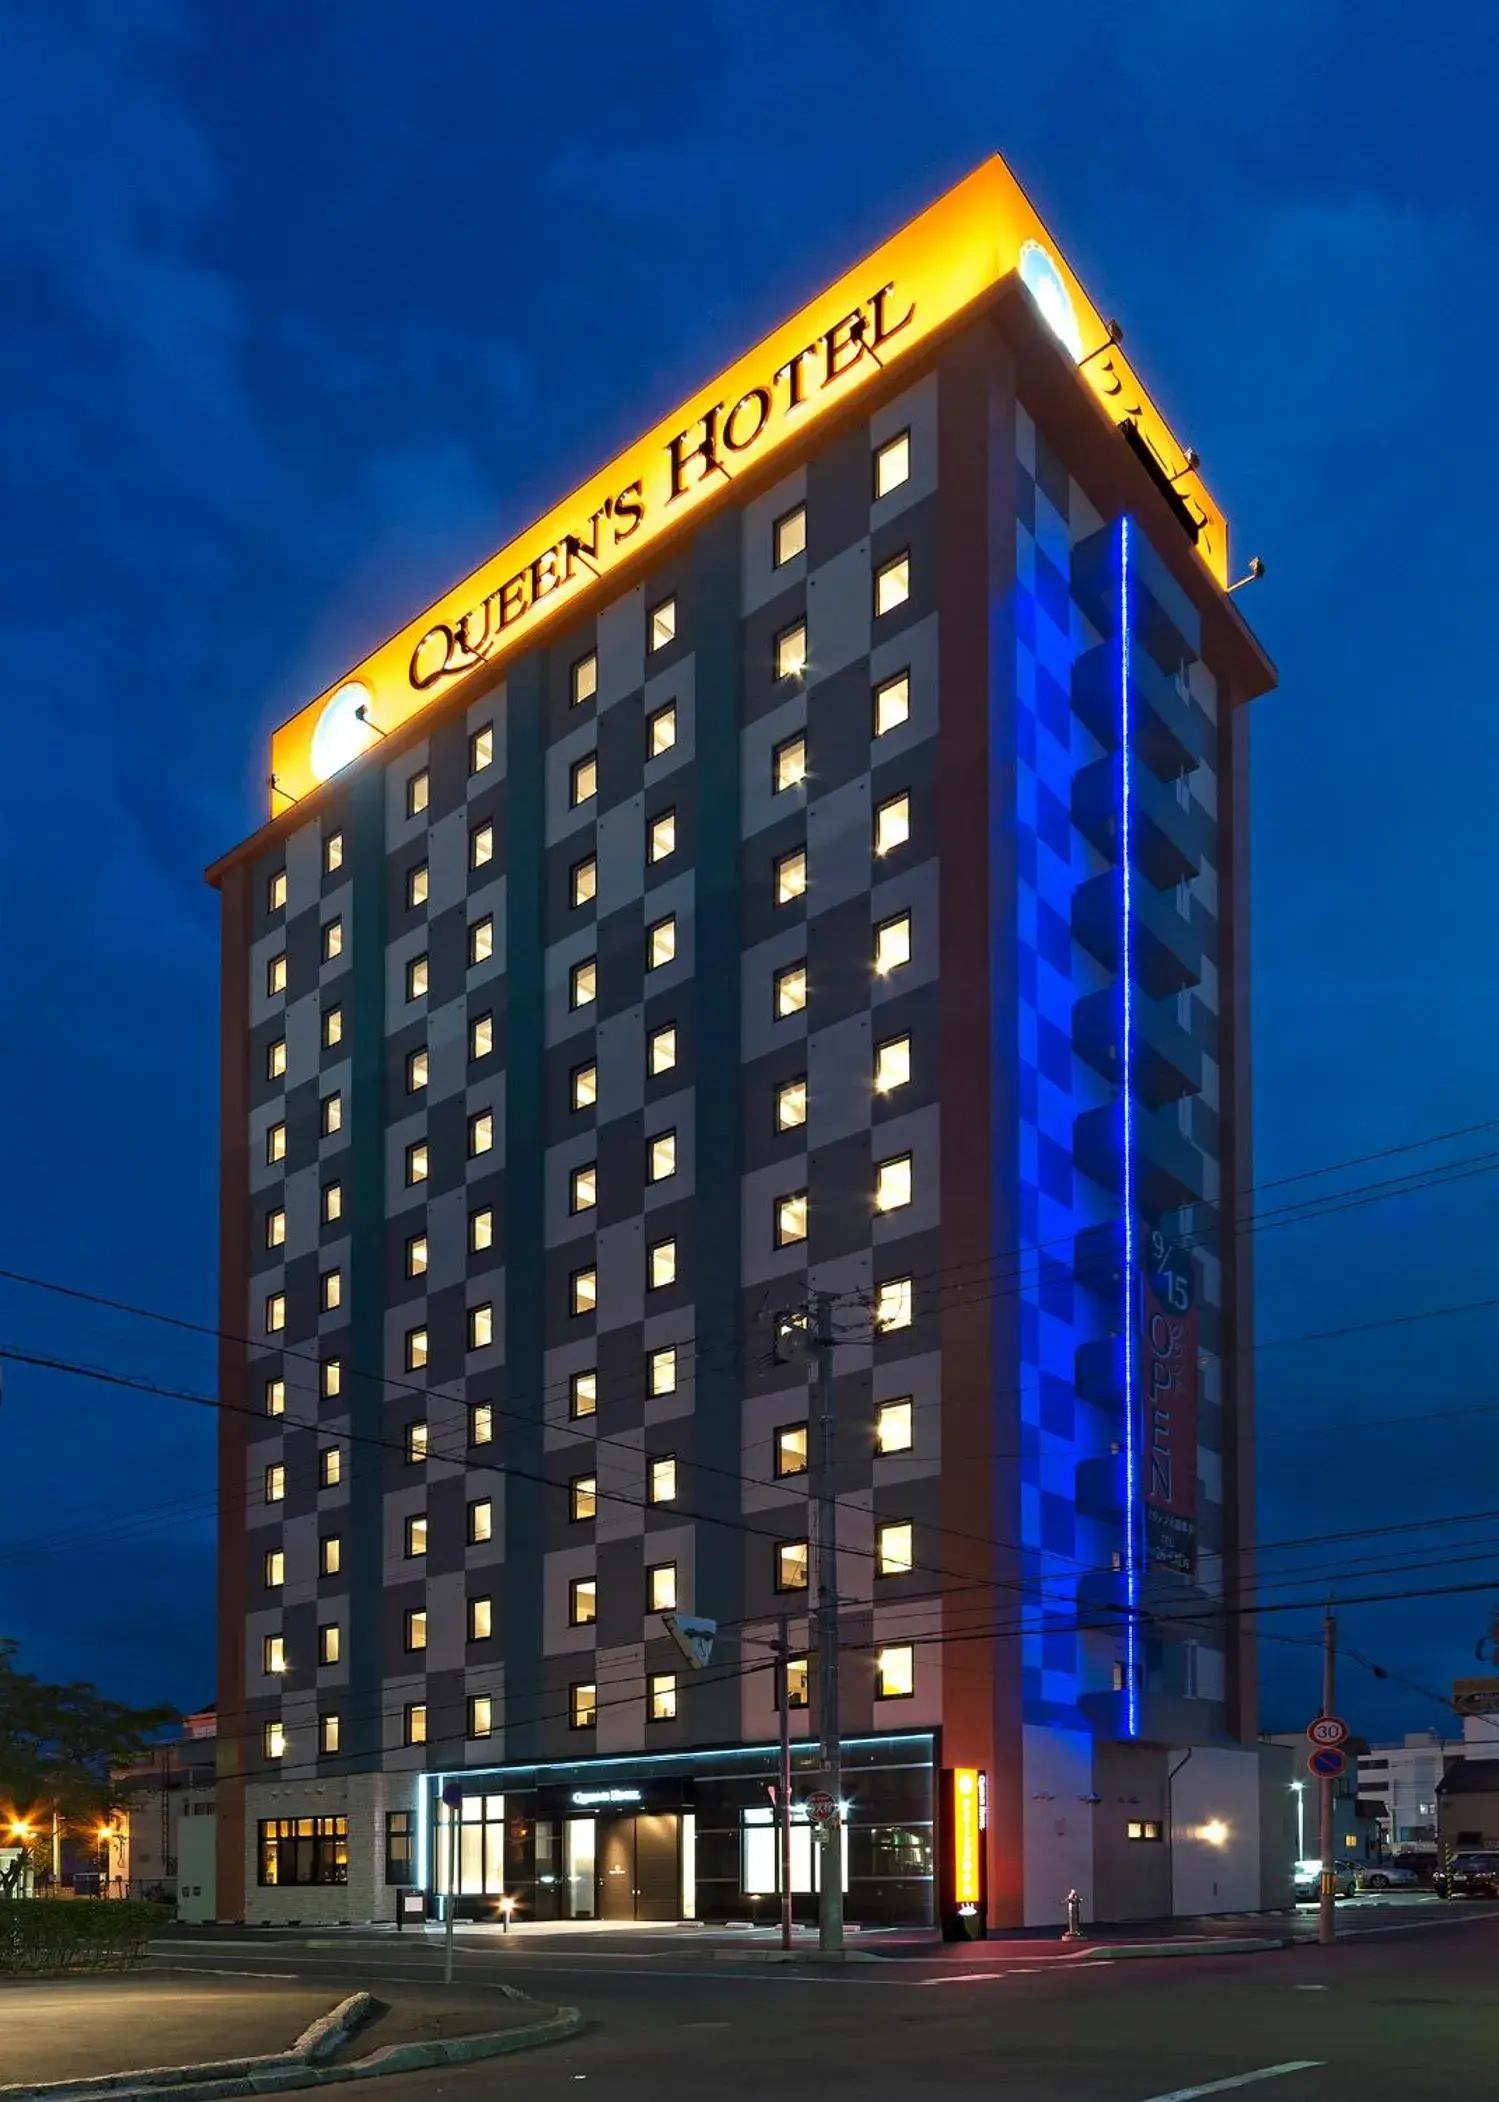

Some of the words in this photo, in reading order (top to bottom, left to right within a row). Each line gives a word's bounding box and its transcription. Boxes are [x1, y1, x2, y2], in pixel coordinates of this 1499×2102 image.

[408, 480, 644, 690] QUEEN'S
[666, 281, 916, 506] HOTEL
[1151, 1230, 1190, 1312] 9/15
[1150, 1313, 1173, 1504] OPEN
[1317, 1725, 1339, 1738] 30
